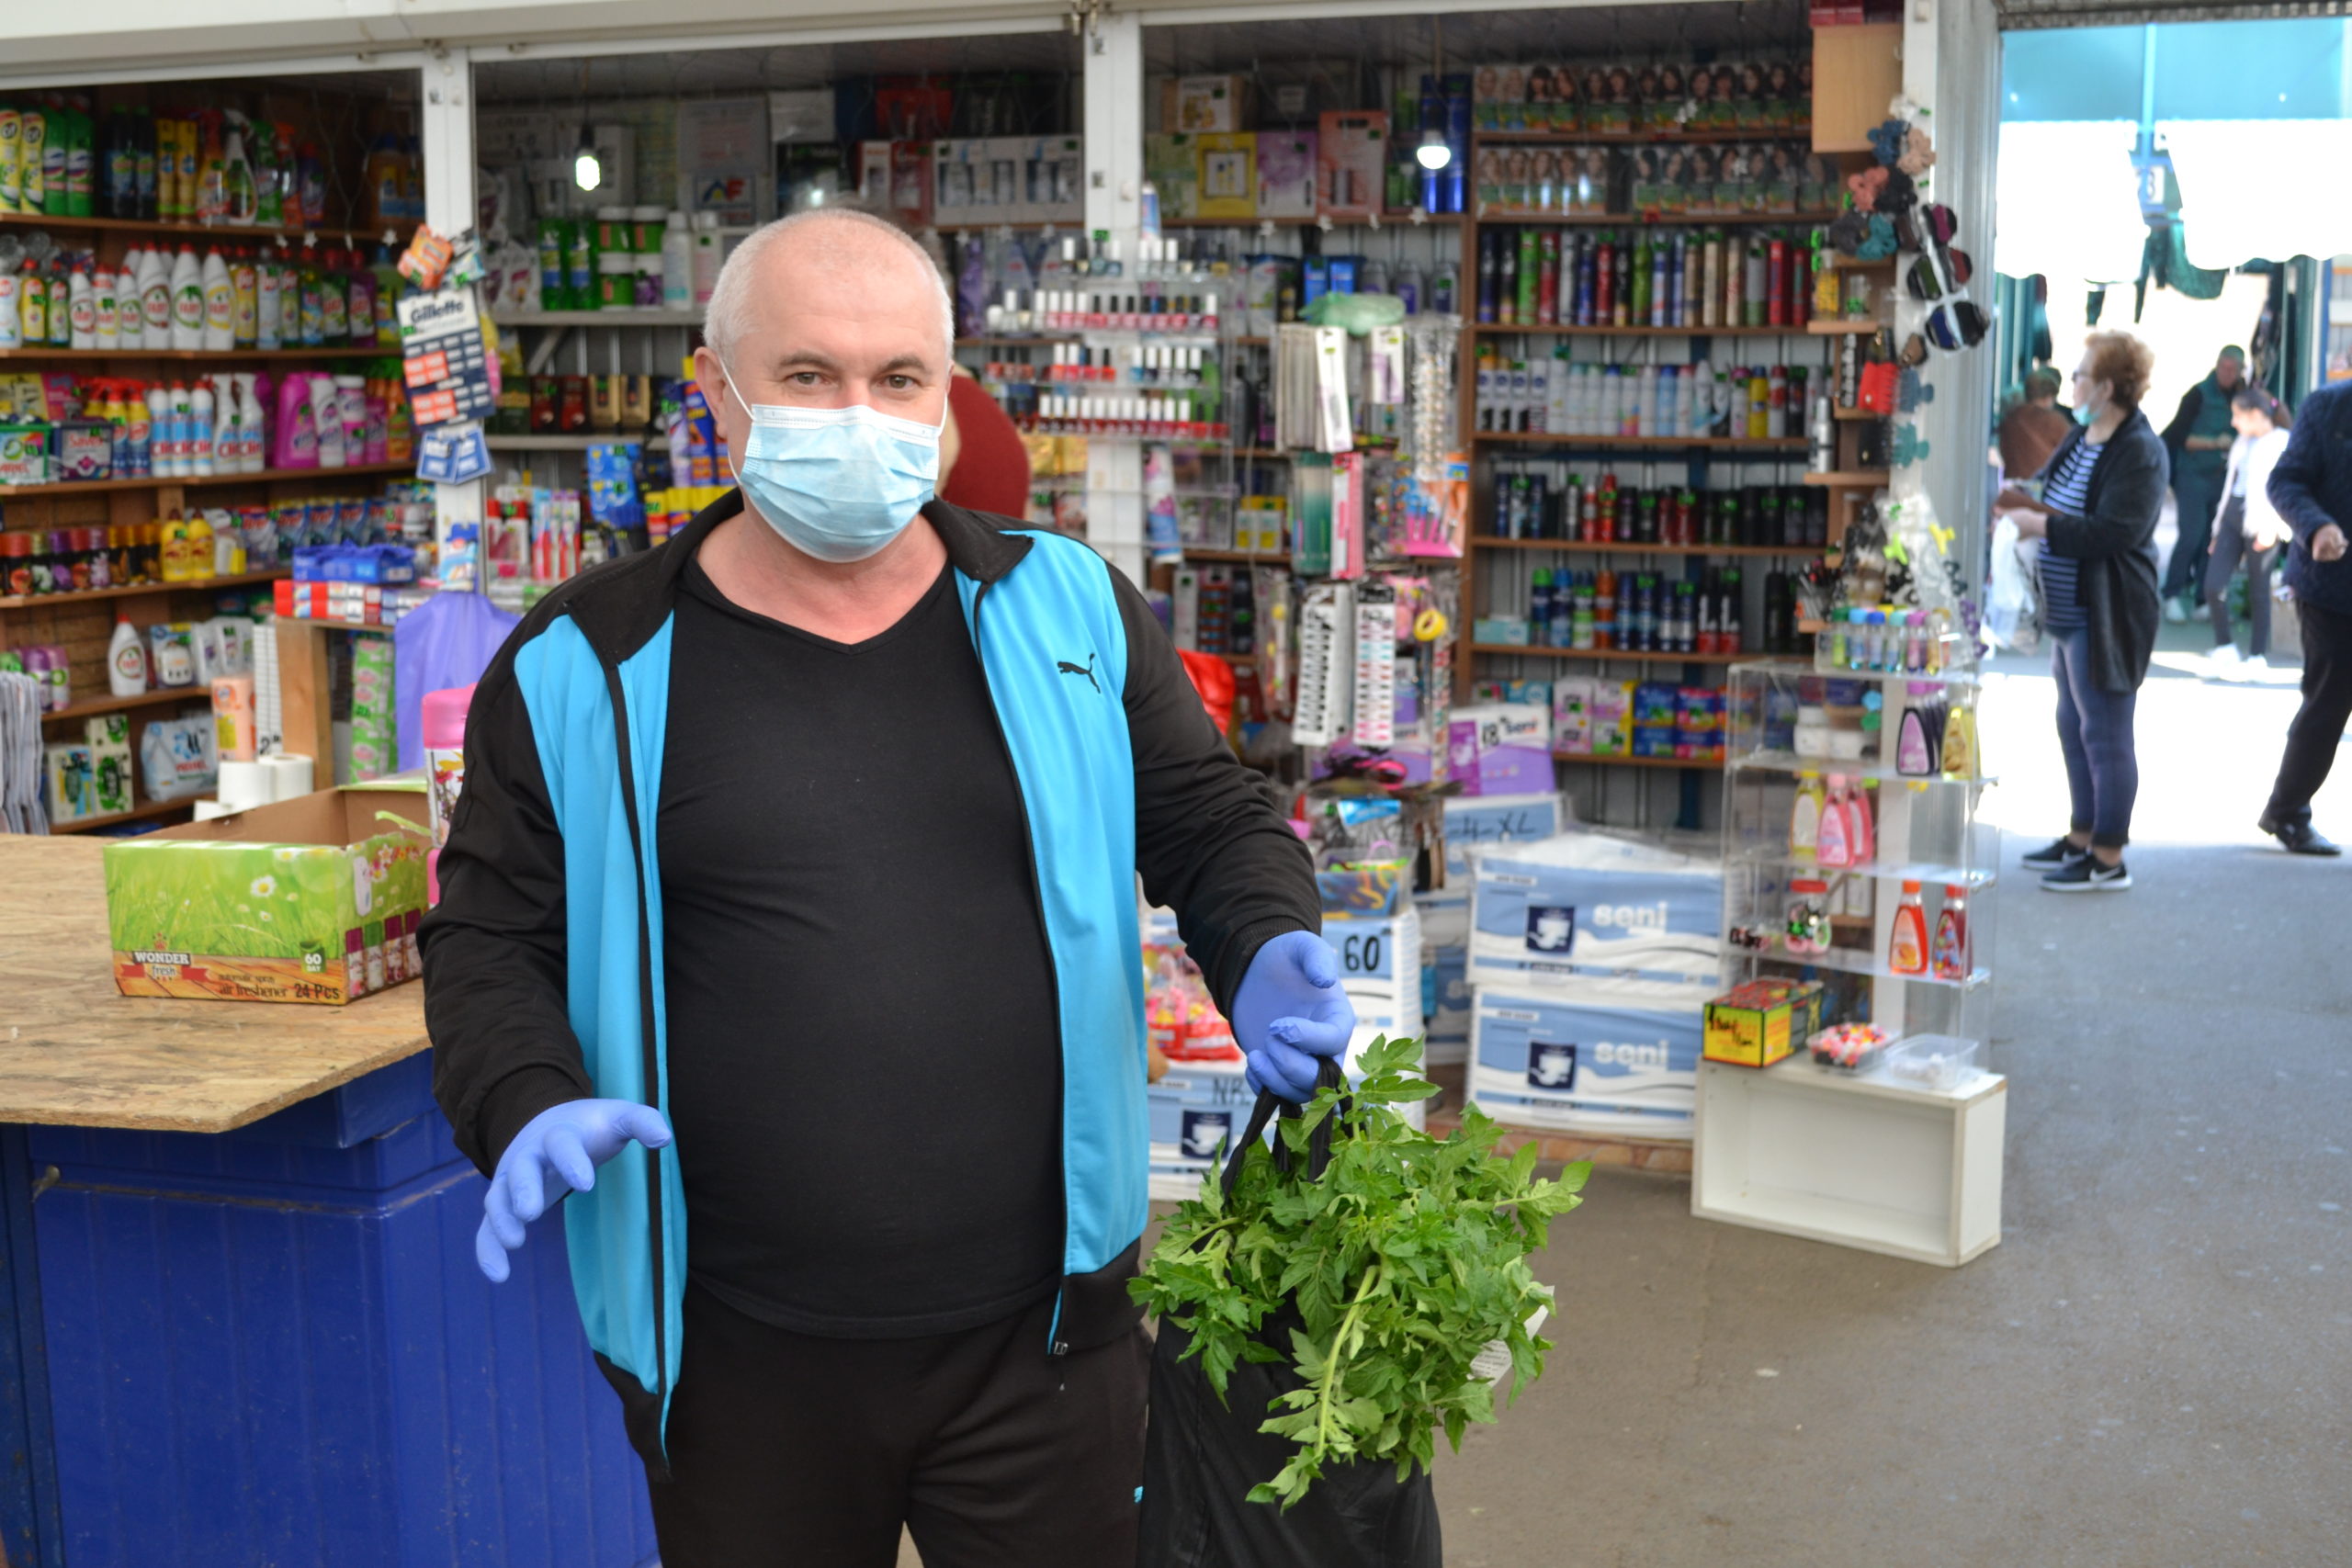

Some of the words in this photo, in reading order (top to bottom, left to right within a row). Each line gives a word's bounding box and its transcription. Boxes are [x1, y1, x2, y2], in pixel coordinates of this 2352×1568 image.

[411, 299, 464, 323] Gillette
[1592, 900, 1669, 927] seni
[134, 952, 190, 964] WONDER
[304, 953, 322, 965] 60
[1344, 934, 1380, 971] 60
[152, 964, 176, 978] fresh
[219, 983, 233, 997] air
[236, 983, 288, 998] freshener
[293, 982, 311, 998] 24
[314, 983, 340, 999] Pcs
[1593, 1039, 1670, 1065] seni
